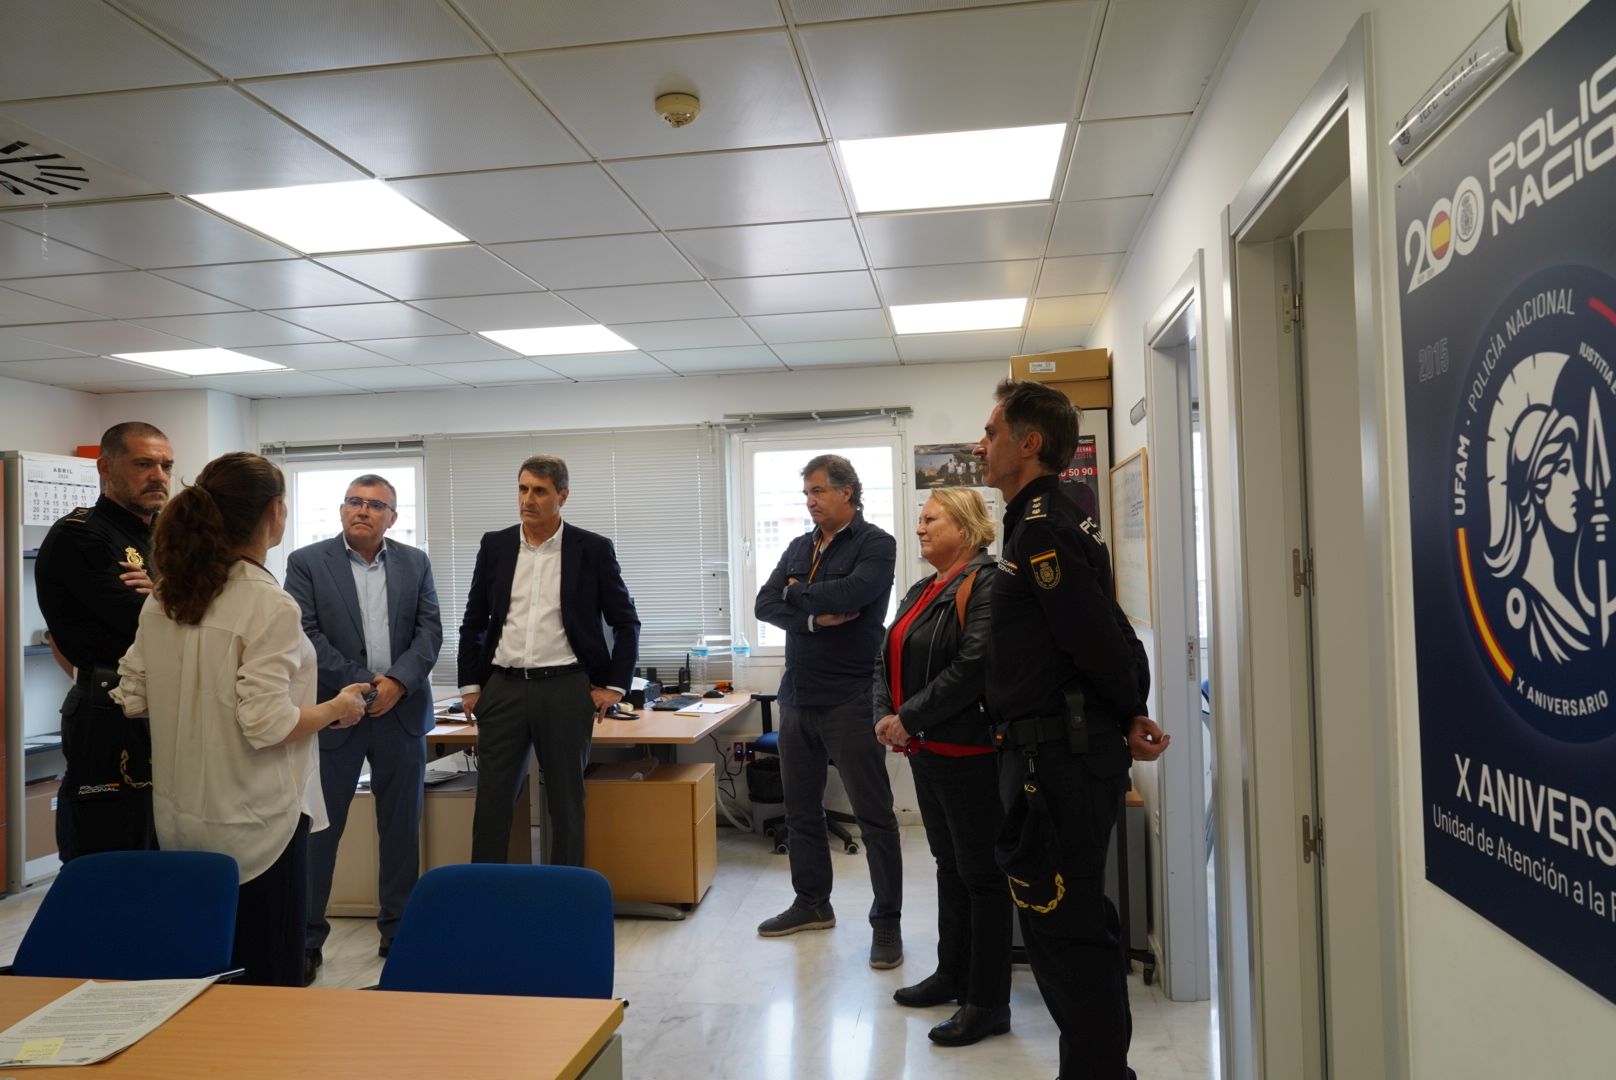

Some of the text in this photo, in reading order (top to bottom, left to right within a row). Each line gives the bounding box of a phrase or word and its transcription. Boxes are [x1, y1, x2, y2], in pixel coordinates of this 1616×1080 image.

[1454, 288, 1575, 516] UFAM POLICÍA NACIONAL
[1579, 341, 1614, 386] IUSTITIA
[1069, 468, 1080, 477] 50
[1082, 467, 1093, 476] 90
[1517, 677, 1609, 717] X ANIVERSARIO
[1454, 753, 1616, 867] X ANIVERS
[1433, 803, 1474, 847] Unidad
[1477, 828, 1494, 857] de
[1497, 836, 1568, 898] Atención
[1573, 880, 1584, 905] a
[1588, 879, 1606, 917] la
